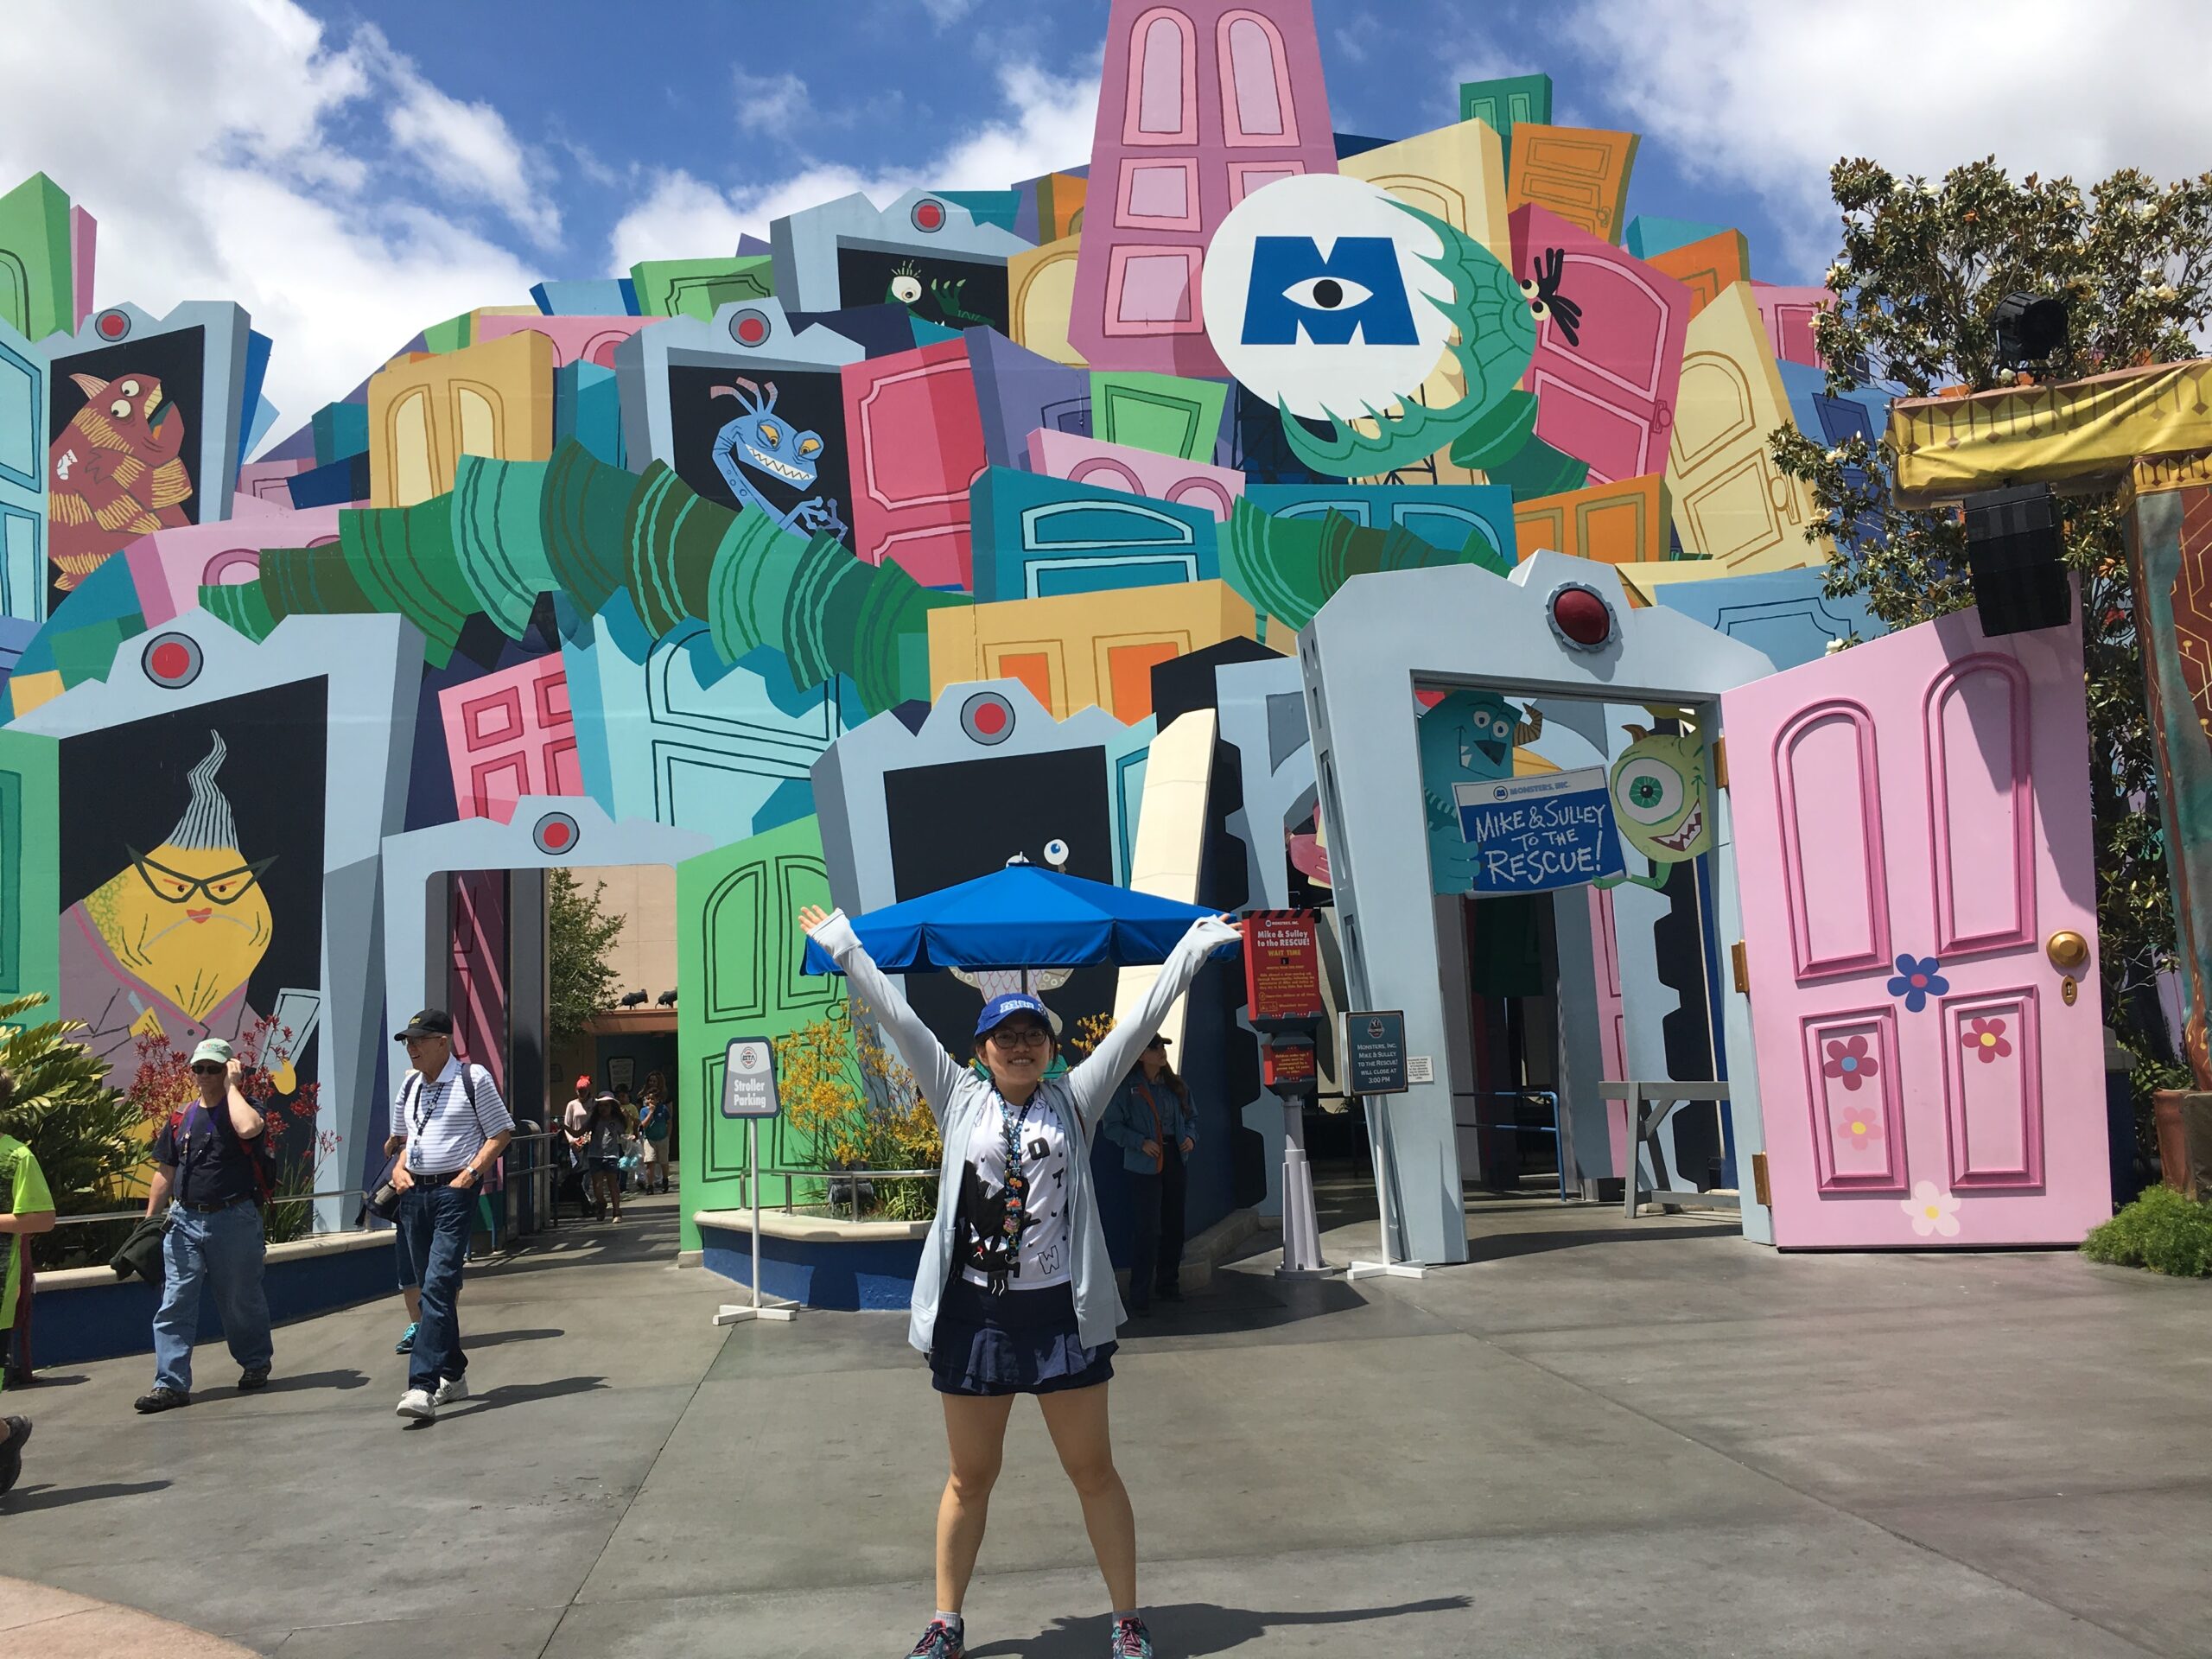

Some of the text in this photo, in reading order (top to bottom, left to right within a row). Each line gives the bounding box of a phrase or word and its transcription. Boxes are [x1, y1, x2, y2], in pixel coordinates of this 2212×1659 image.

[1241, 236, 1420, 346] M
[1510, 784, 1554, 795] MONSTERS,
[1554, 781, 1571, 790] INC.
[1476, 800, 1606, 843] MIKE & SULLEY
[1511, 829, 1579, 851] TO THE
[1484, 830, 1603, 885] RESCUE!
[1285, 930, 1308, 938] Sulley
[734, 1078, 765, 1091] Stroller
[734, 1093, 766, 1109] Parking
